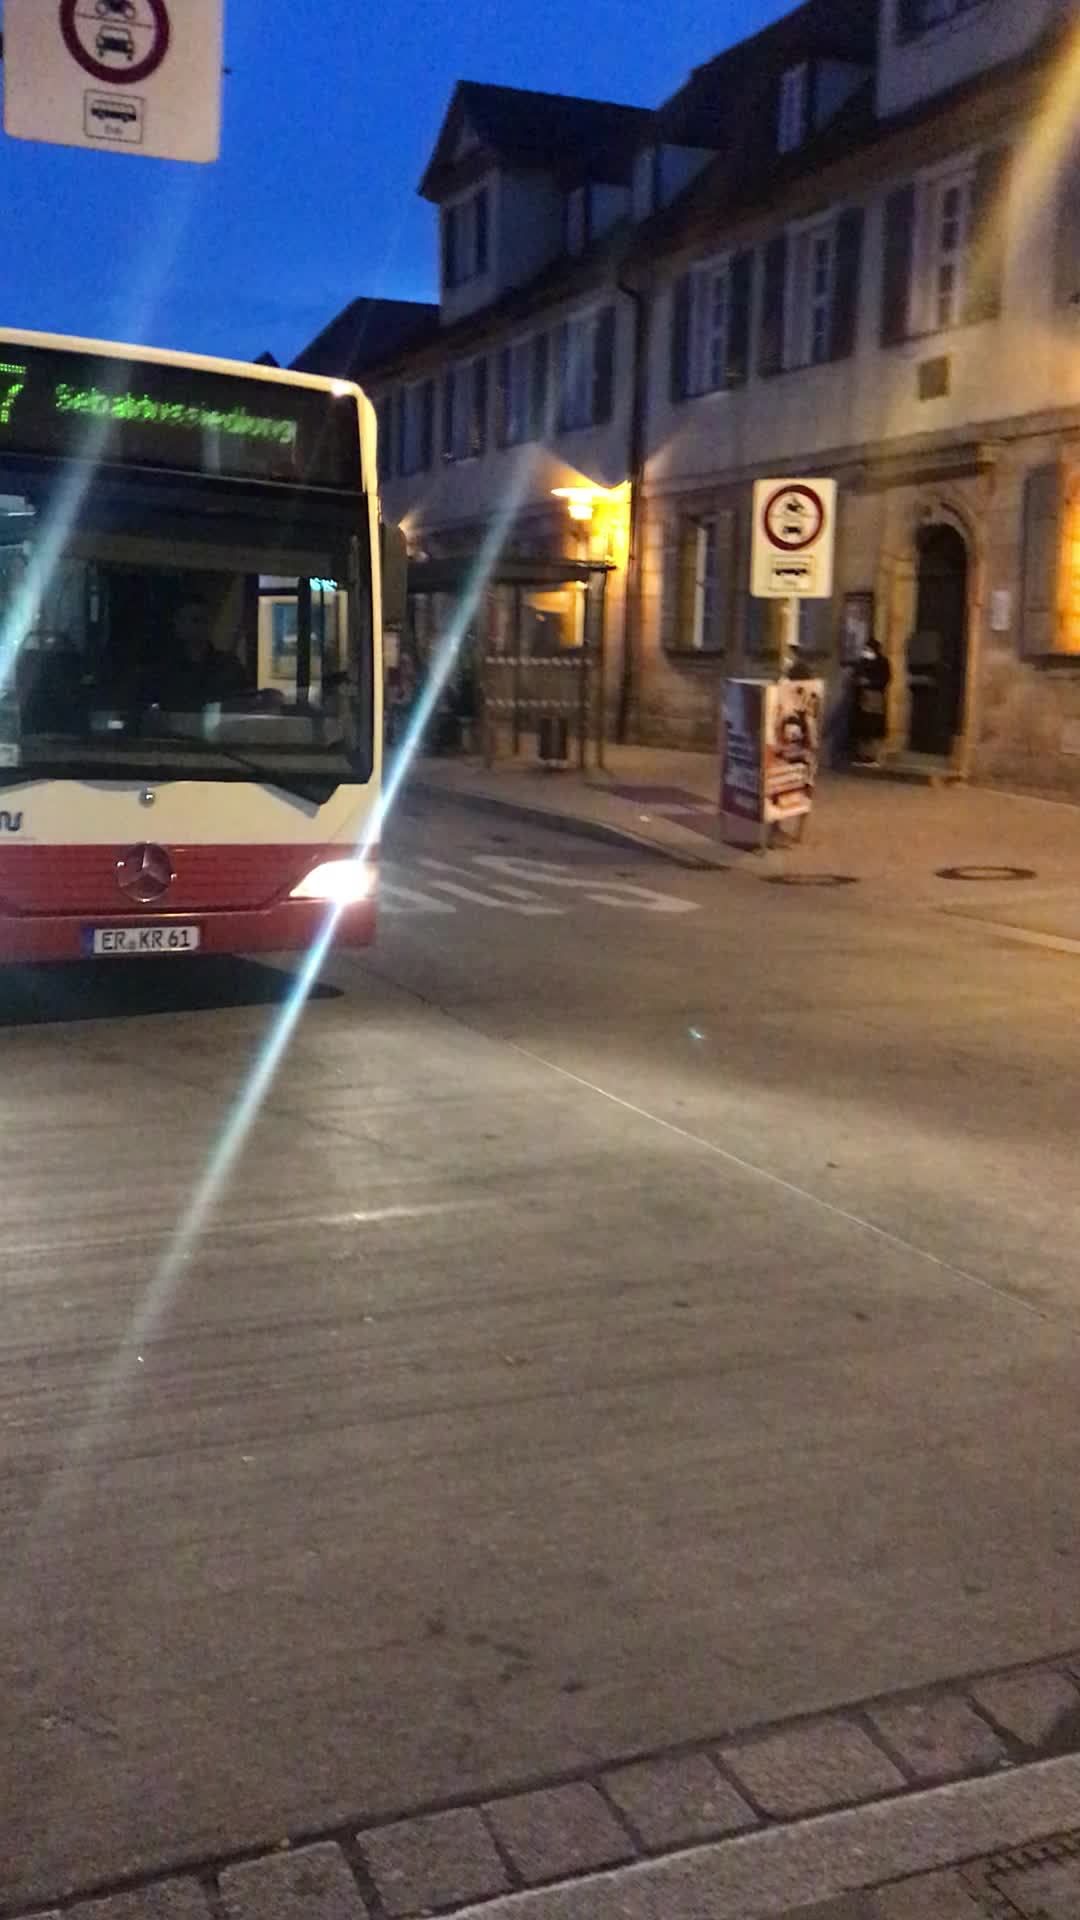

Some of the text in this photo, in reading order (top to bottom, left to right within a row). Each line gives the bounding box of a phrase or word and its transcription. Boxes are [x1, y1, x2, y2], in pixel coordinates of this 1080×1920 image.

[102, 928, 191, 951] ER KR 61
